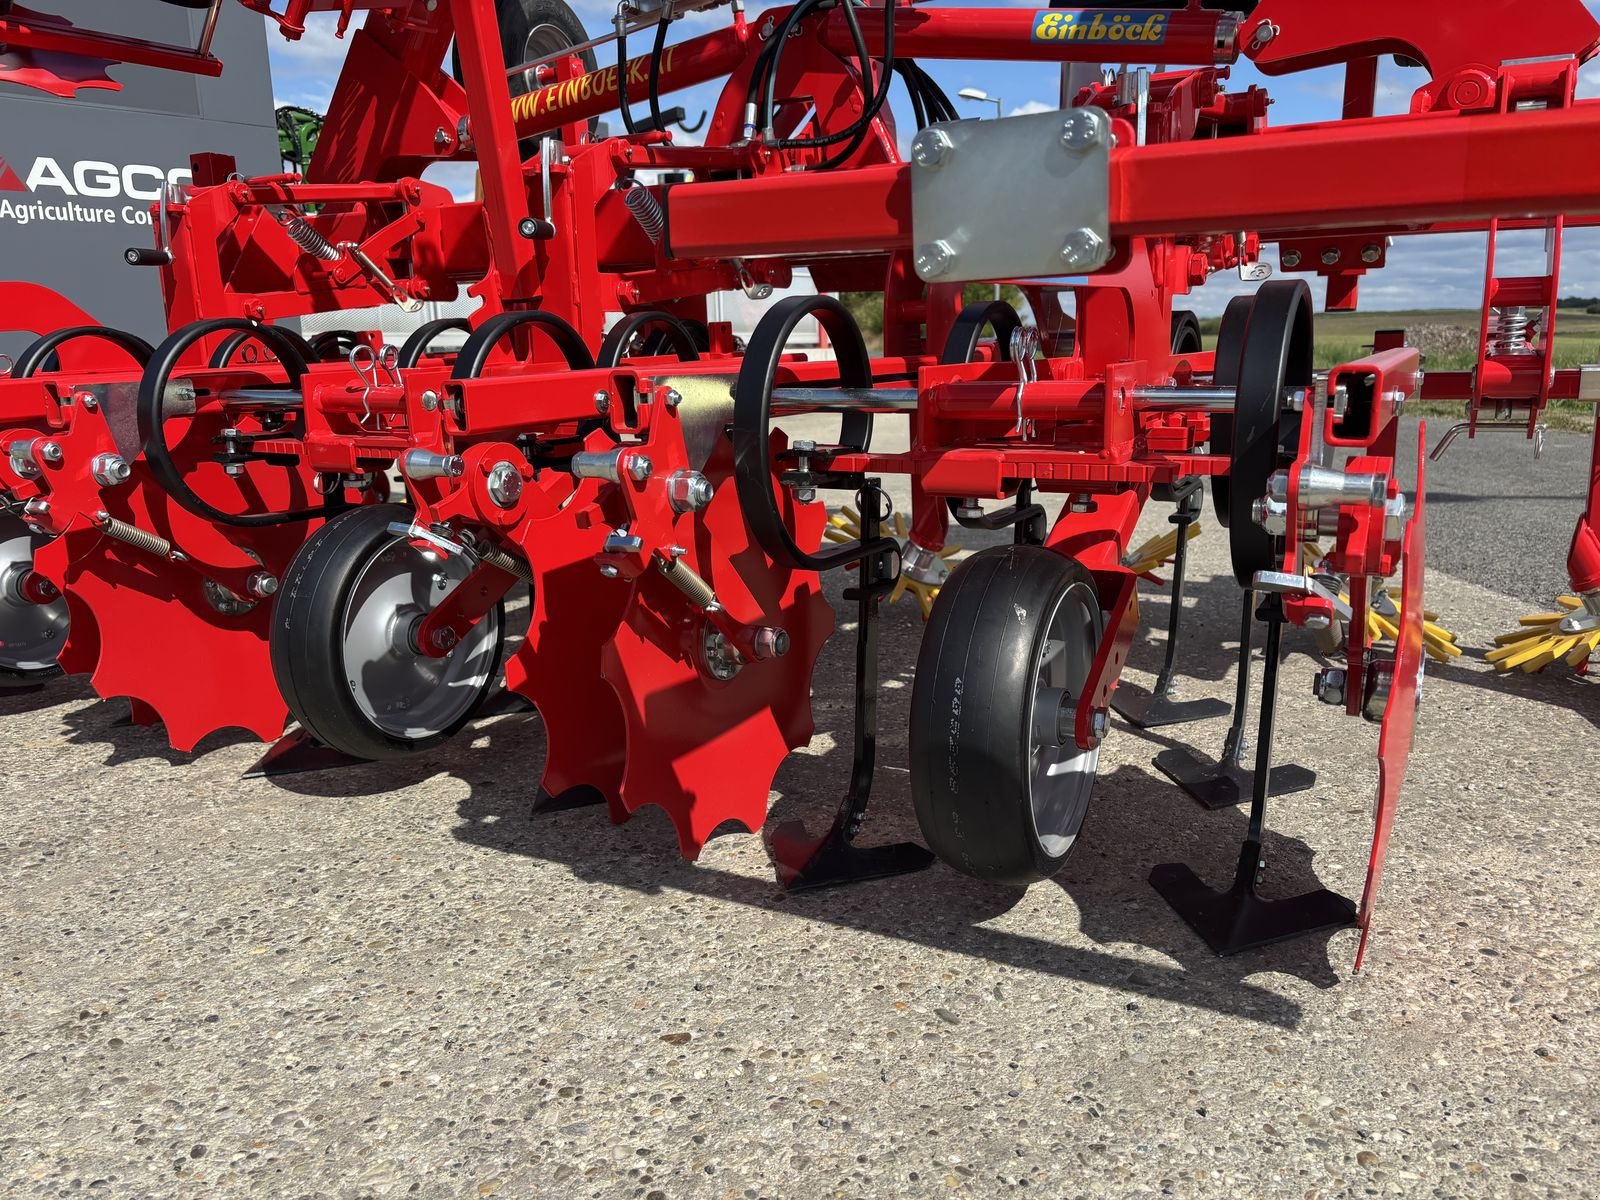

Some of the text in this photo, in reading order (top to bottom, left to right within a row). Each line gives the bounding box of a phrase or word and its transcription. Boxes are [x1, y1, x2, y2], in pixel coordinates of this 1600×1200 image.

[1035, 12, 1166, 41] Einböck
[0, 199, 154, 225] Agriculture Co
